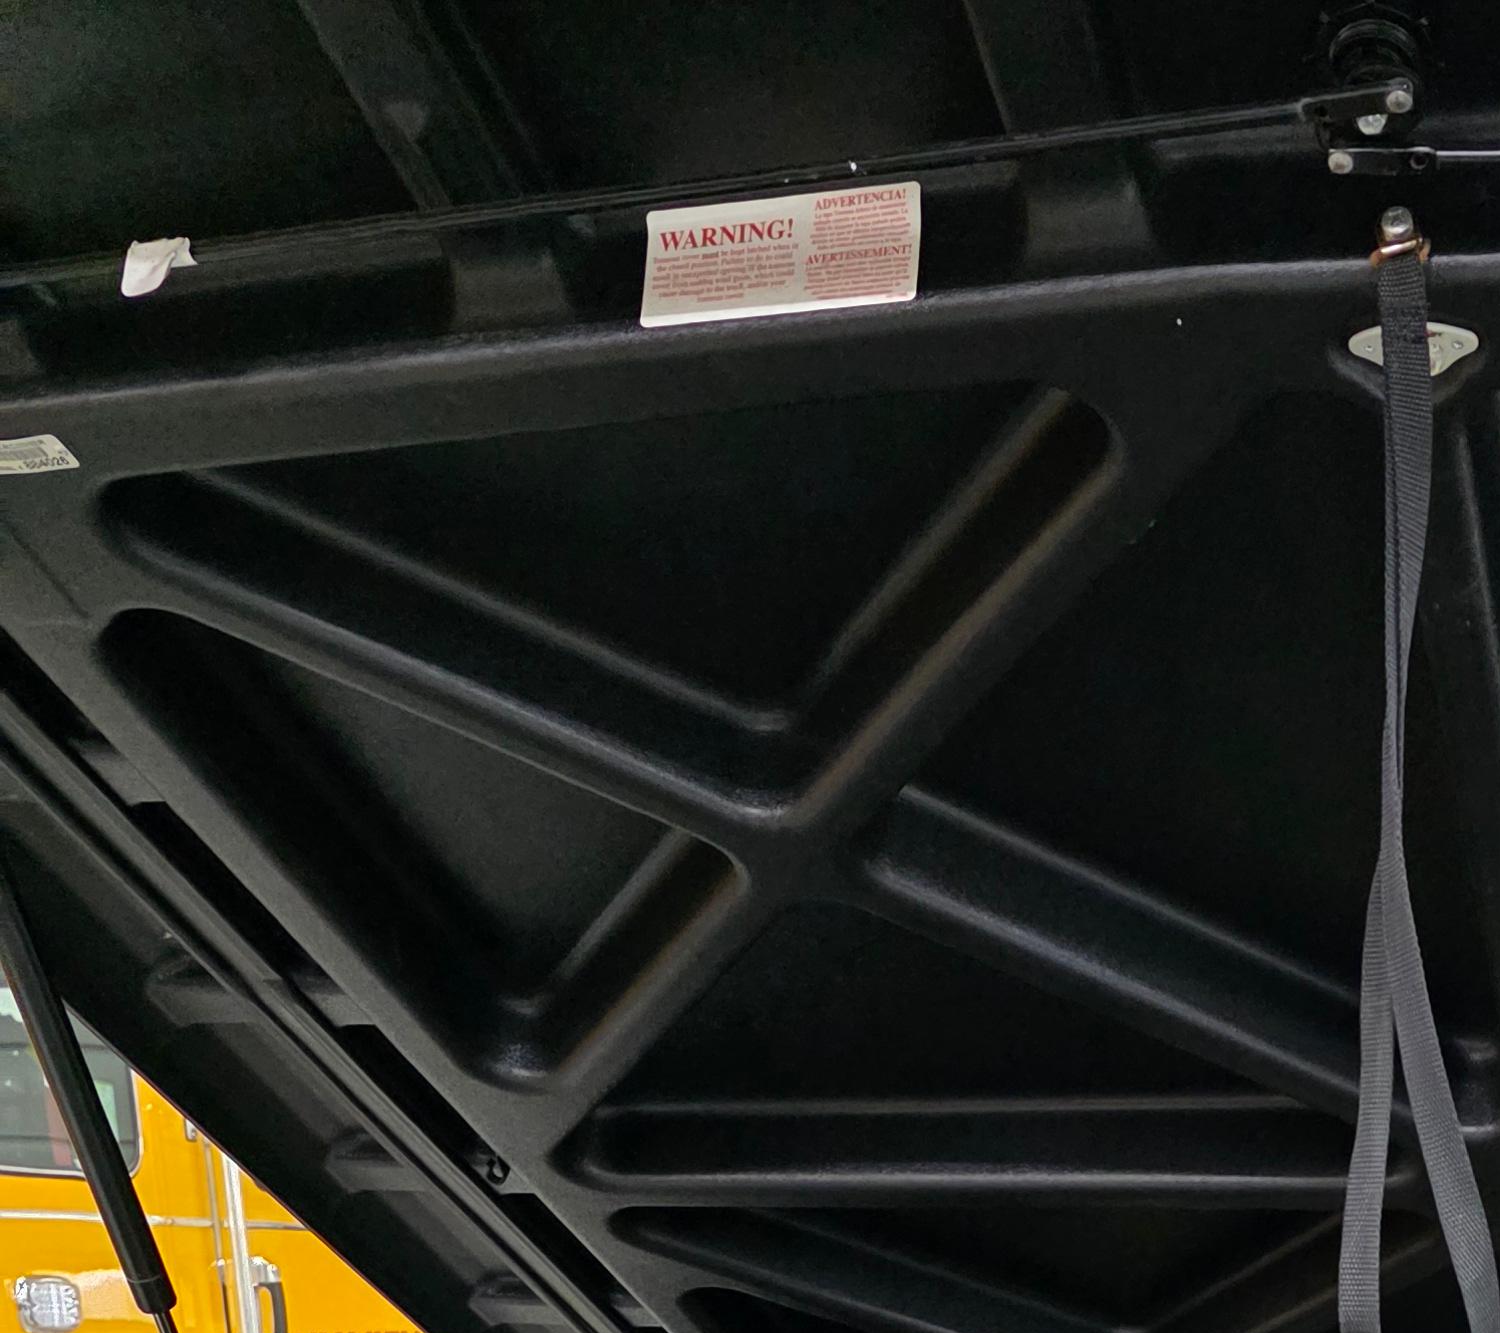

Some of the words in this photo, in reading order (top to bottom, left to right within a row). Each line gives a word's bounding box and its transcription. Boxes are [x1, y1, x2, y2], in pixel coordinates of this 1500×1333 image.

[814, 188, 907, 211] ADVERTENCIA!
[659, 217, 795, 252] WARNING!
[804, 243, 913, 266] AVERTISSEMENT!
